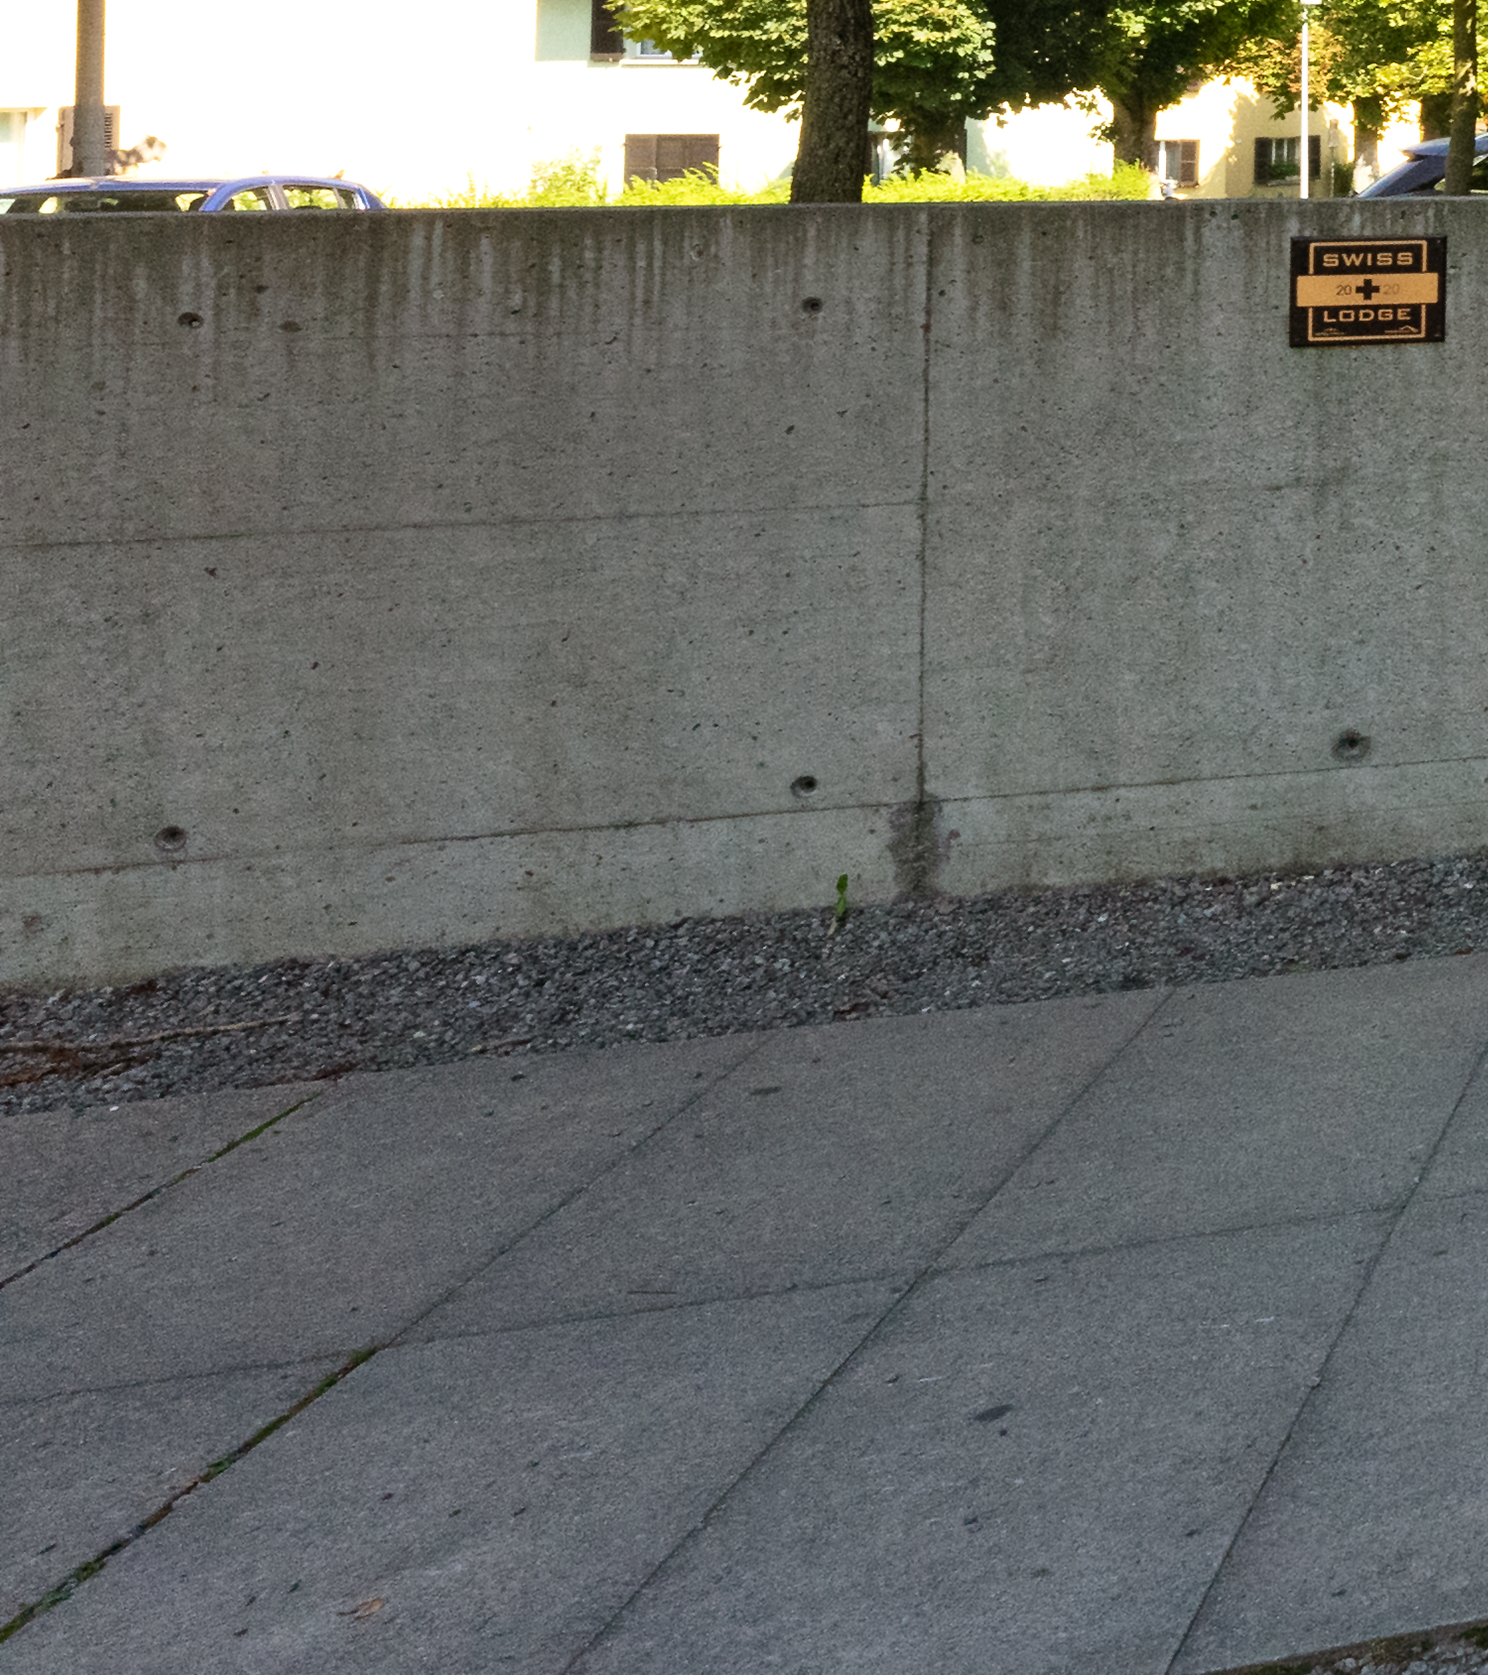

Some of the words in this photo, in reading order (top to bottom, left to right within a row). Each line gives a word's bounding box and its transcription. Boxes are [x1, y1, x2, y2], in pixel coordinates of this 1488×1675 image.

[1322, 252, 1413, 267] SWISS
[1336, 284, 1352, 296] 20
[1323, 308, 1411, 323] LODGE
